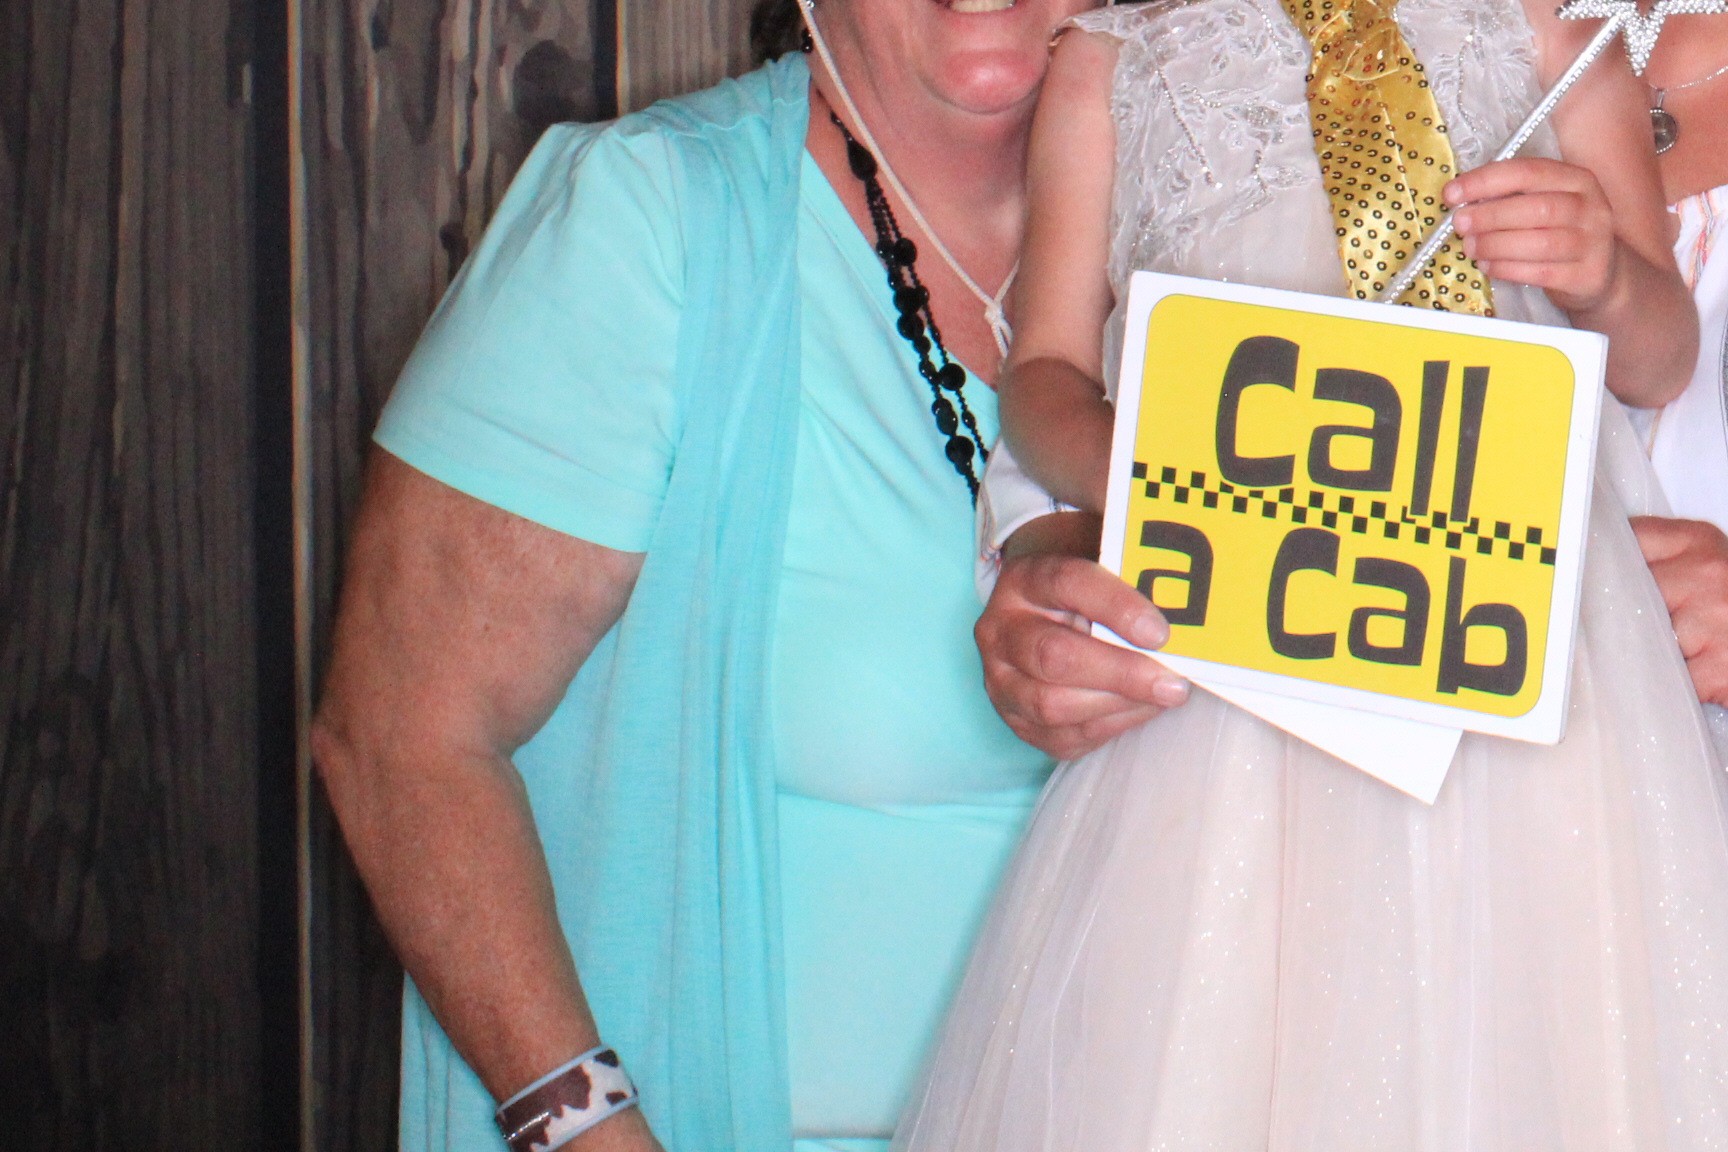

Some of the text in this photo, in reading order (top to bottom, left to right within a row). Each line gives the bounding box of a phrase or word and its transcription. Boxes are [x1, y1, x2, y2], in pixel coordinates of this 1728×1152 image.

[1215, 335, 1491, 522] Call
[1135, 520, 1528, 697] a Cab
